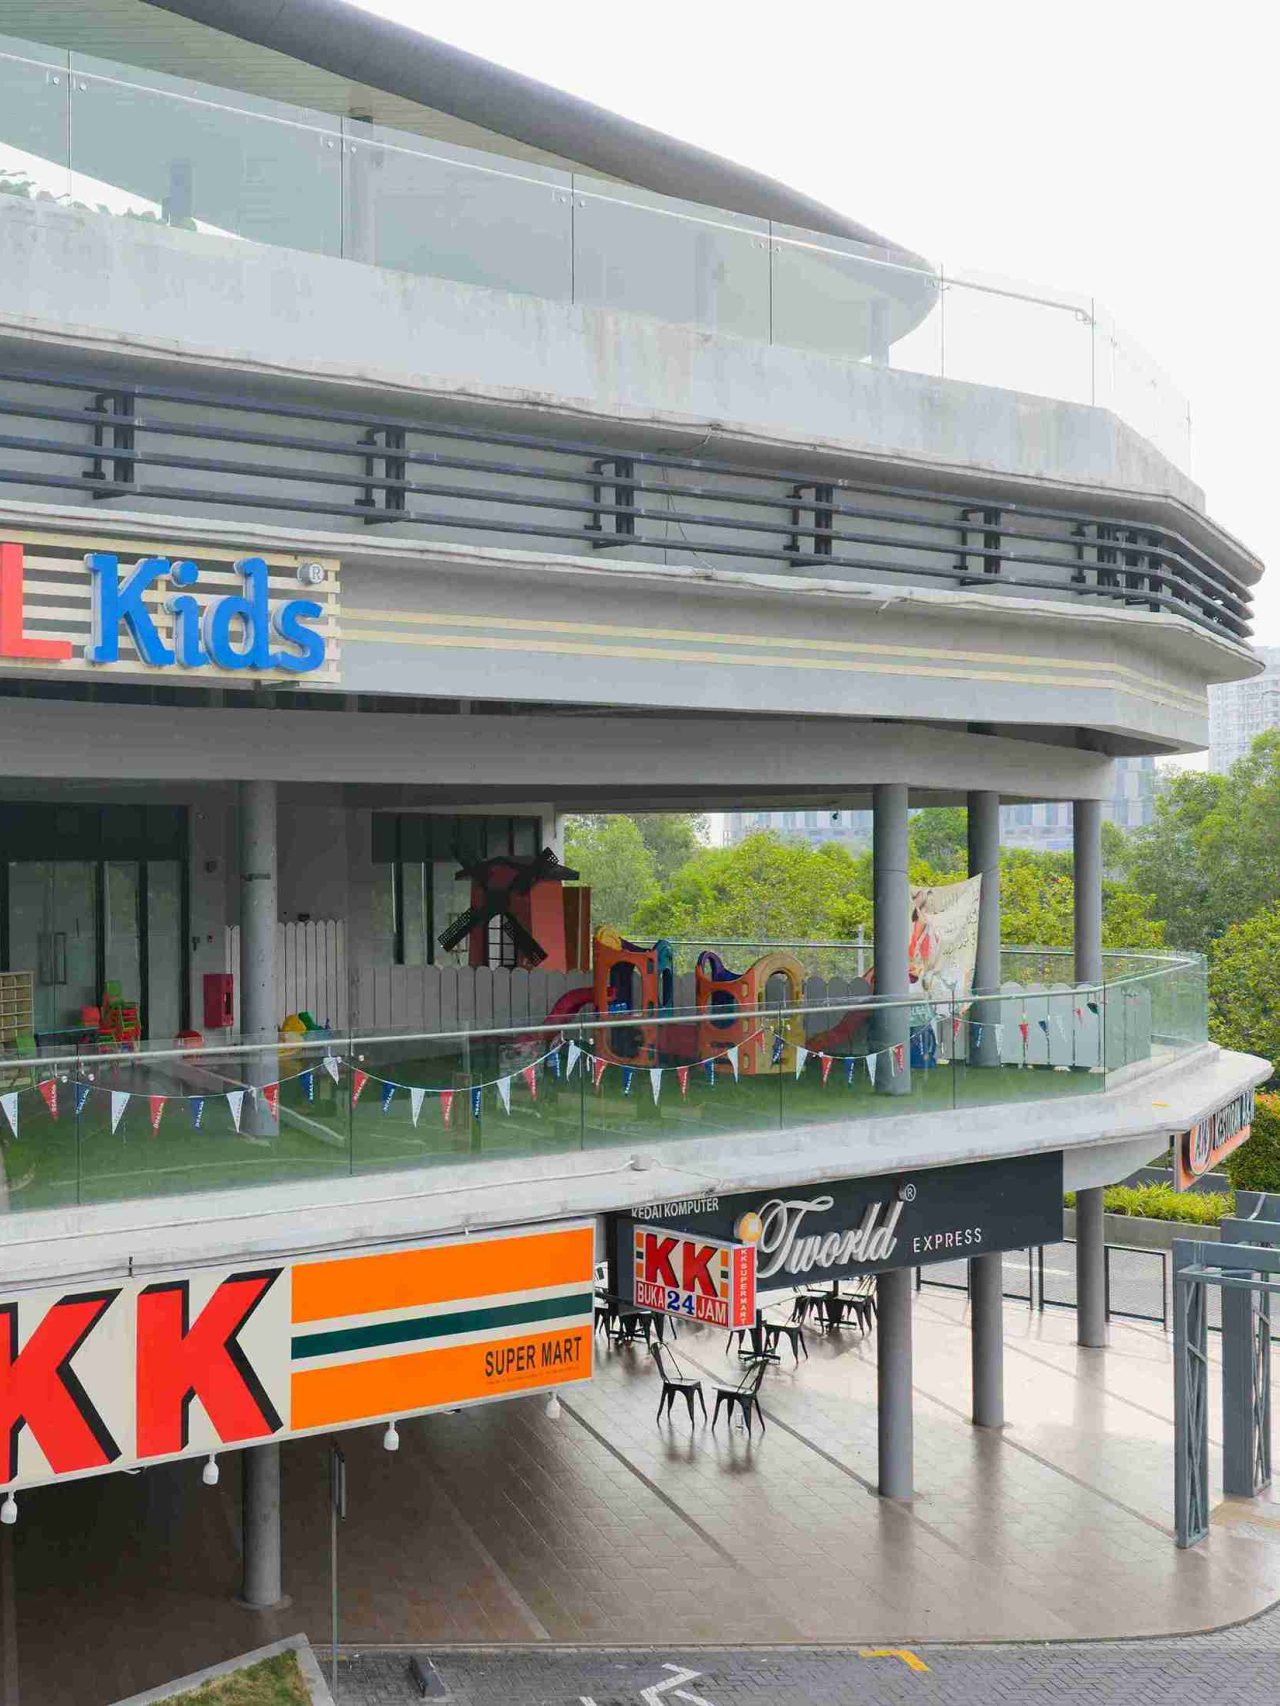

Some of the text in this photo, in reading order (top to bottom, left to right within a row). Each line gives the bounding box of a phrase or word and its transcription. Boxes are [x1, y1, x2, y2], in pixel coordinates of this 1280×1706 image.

[631, 1197, 719, 1220] KEDAI KOMPUTER
[913, 1228, 983, 1254] EXPRESS
[645, 1233, 718, 1297] KK
[637, 1281, 727, 1324] BUKA 24 JAM
[485, 1345, 535, 1376] SUPER
[541, 1337, 582, 1368] MART
